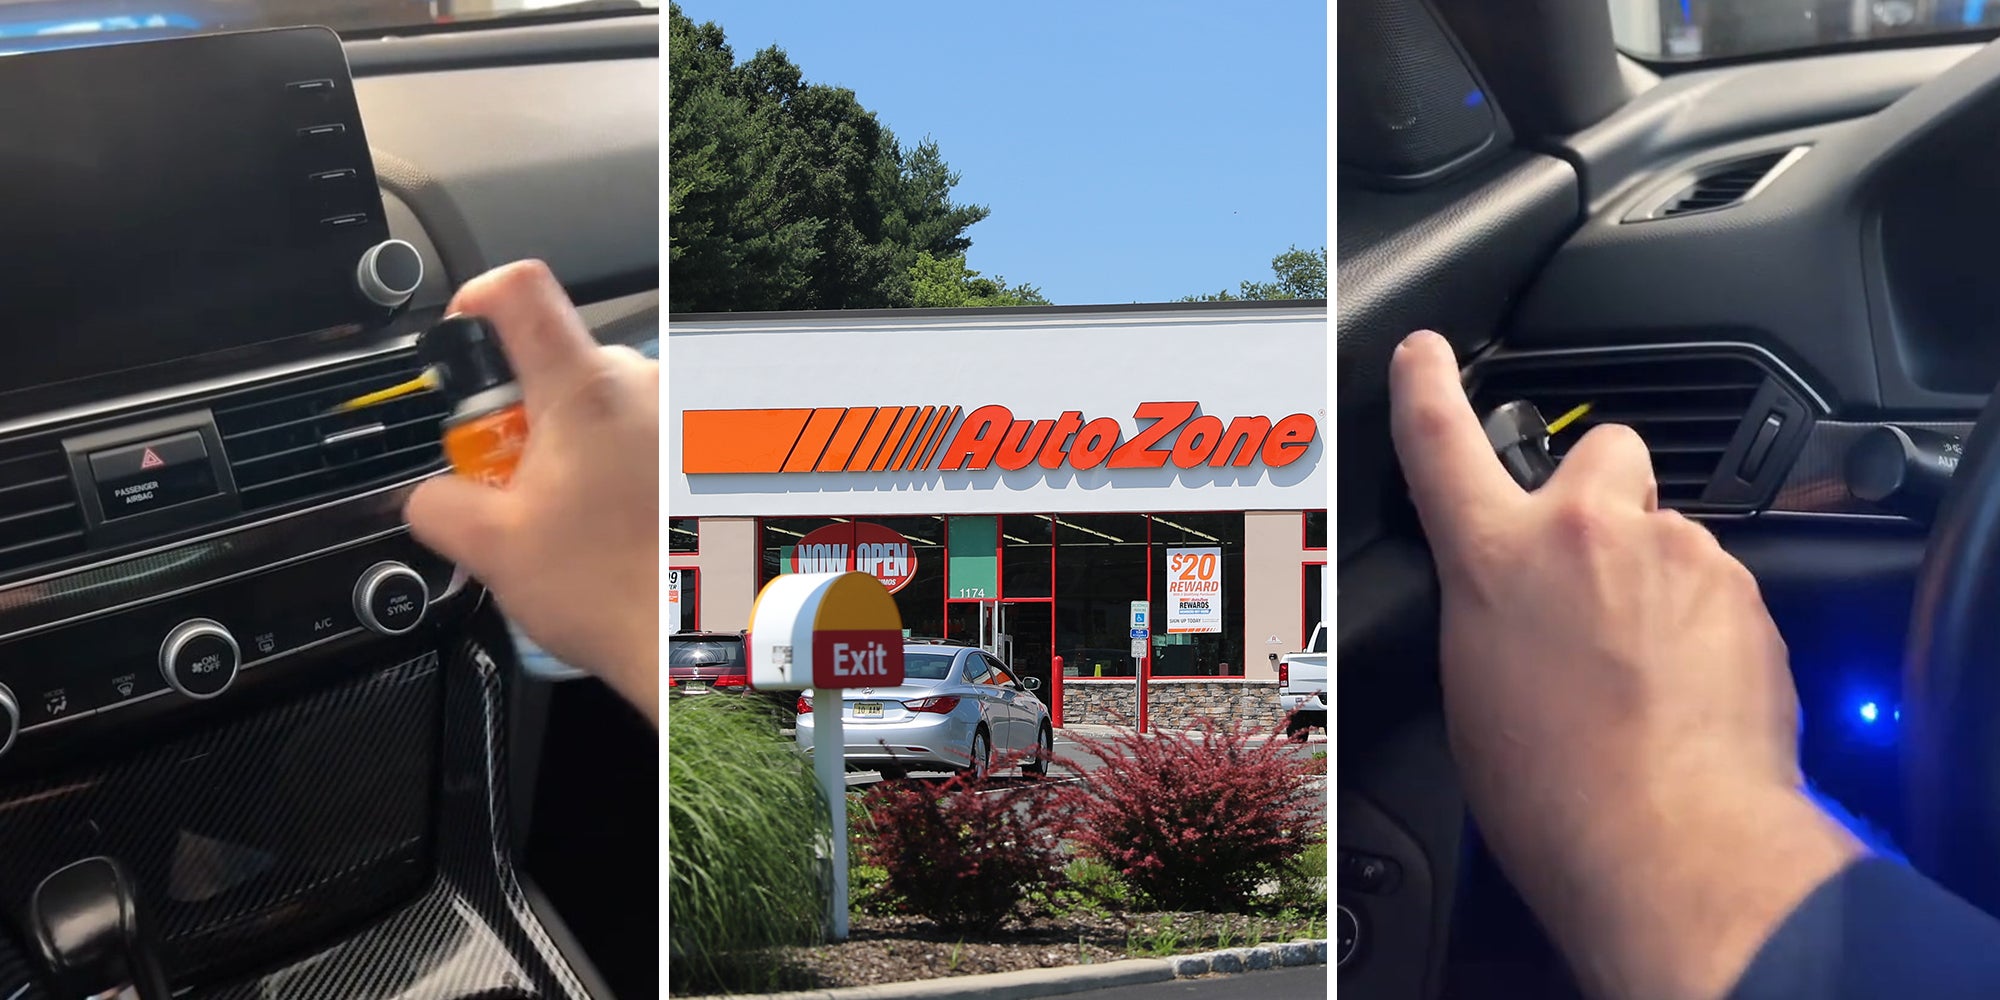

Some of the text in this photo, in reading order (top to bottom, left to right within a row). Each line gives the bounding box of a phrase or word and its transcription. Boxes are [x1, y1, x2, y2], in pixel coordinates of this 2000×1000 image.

[937, 401, 1317, 471] AutoZone
[1938, 455, 1959, 469] AUT
[114, 480, 159, 498] PASSENGER
[126, 490, 154, 504] AIRBAG
[798, 542, 908, 577] NOW OPEN
[1170, 553, 1216, 581] $20
[960, 588, 985, 598] 1174
[1169, 580, 1219, 592] REWARD
[387, 601, 414, 616] SYNC
[1179, 601, 1210, 609] REWARDS
[314, 617, 333, 631] A/C
[201, 653, 219, 665] ON/
[832, 641, 888, 677] Exit
[203, 660, 220, 673] OFF
